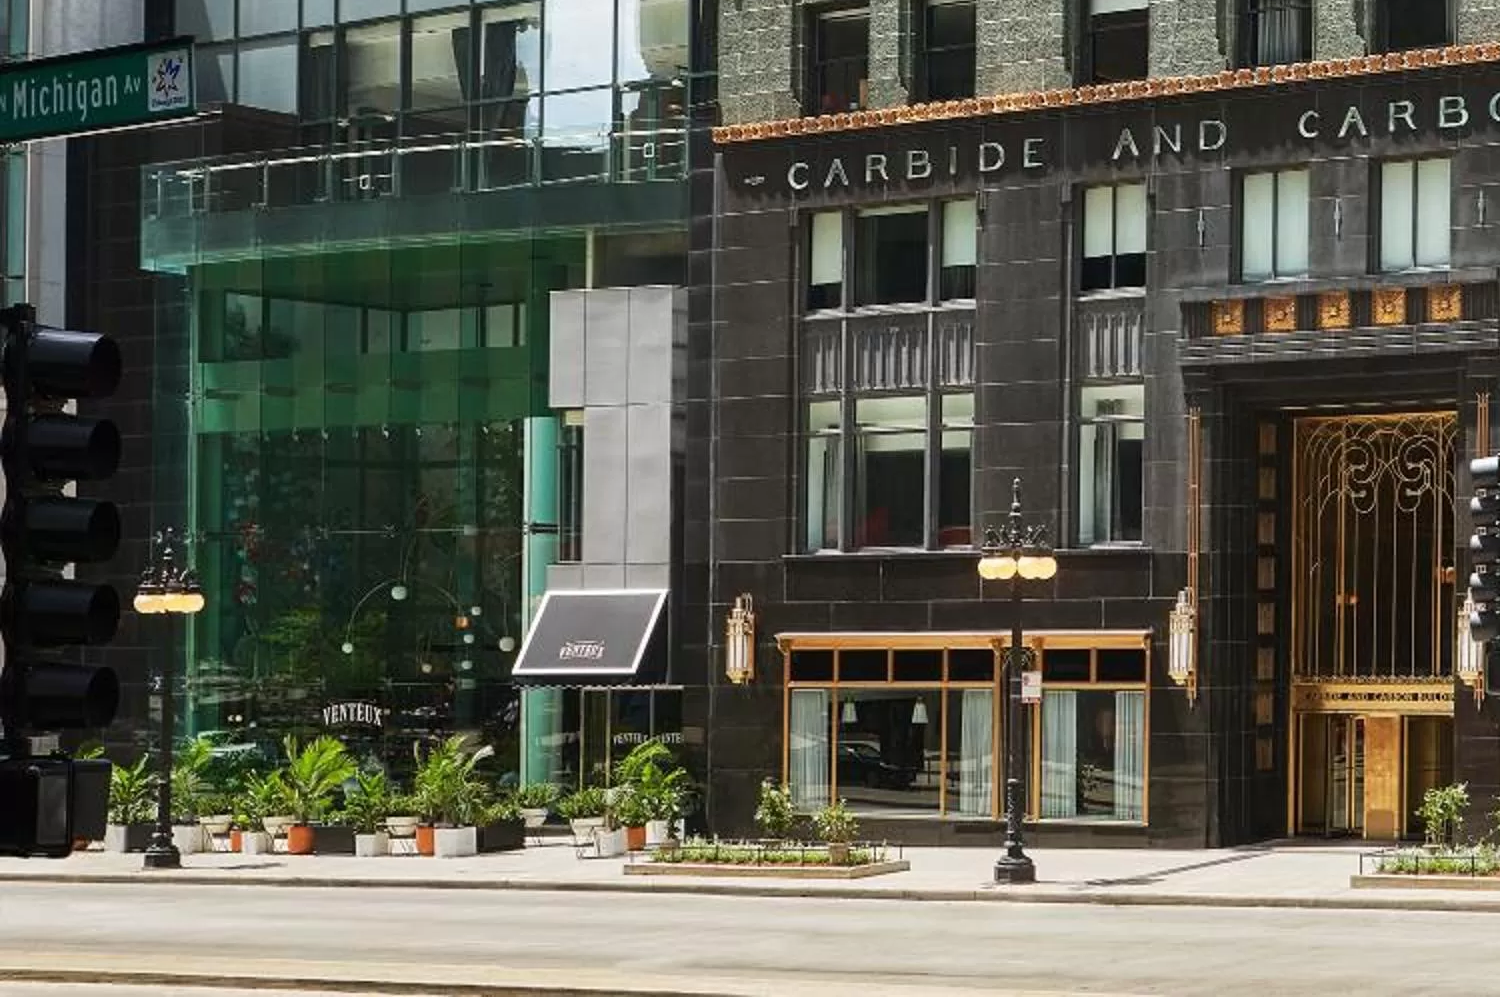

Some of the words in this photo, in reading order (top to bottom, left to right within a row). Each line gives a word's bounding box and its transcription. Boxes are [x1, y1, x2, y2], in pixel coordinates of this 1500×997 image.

[13, 72, 117, 122] Michigan
[124, 74, 141, 95] Av
[787, 138, 1045, 190] CARBIDE
[1111, 120, 1227, 160] AND
[323, 703, 382, 726] VENTEUX
